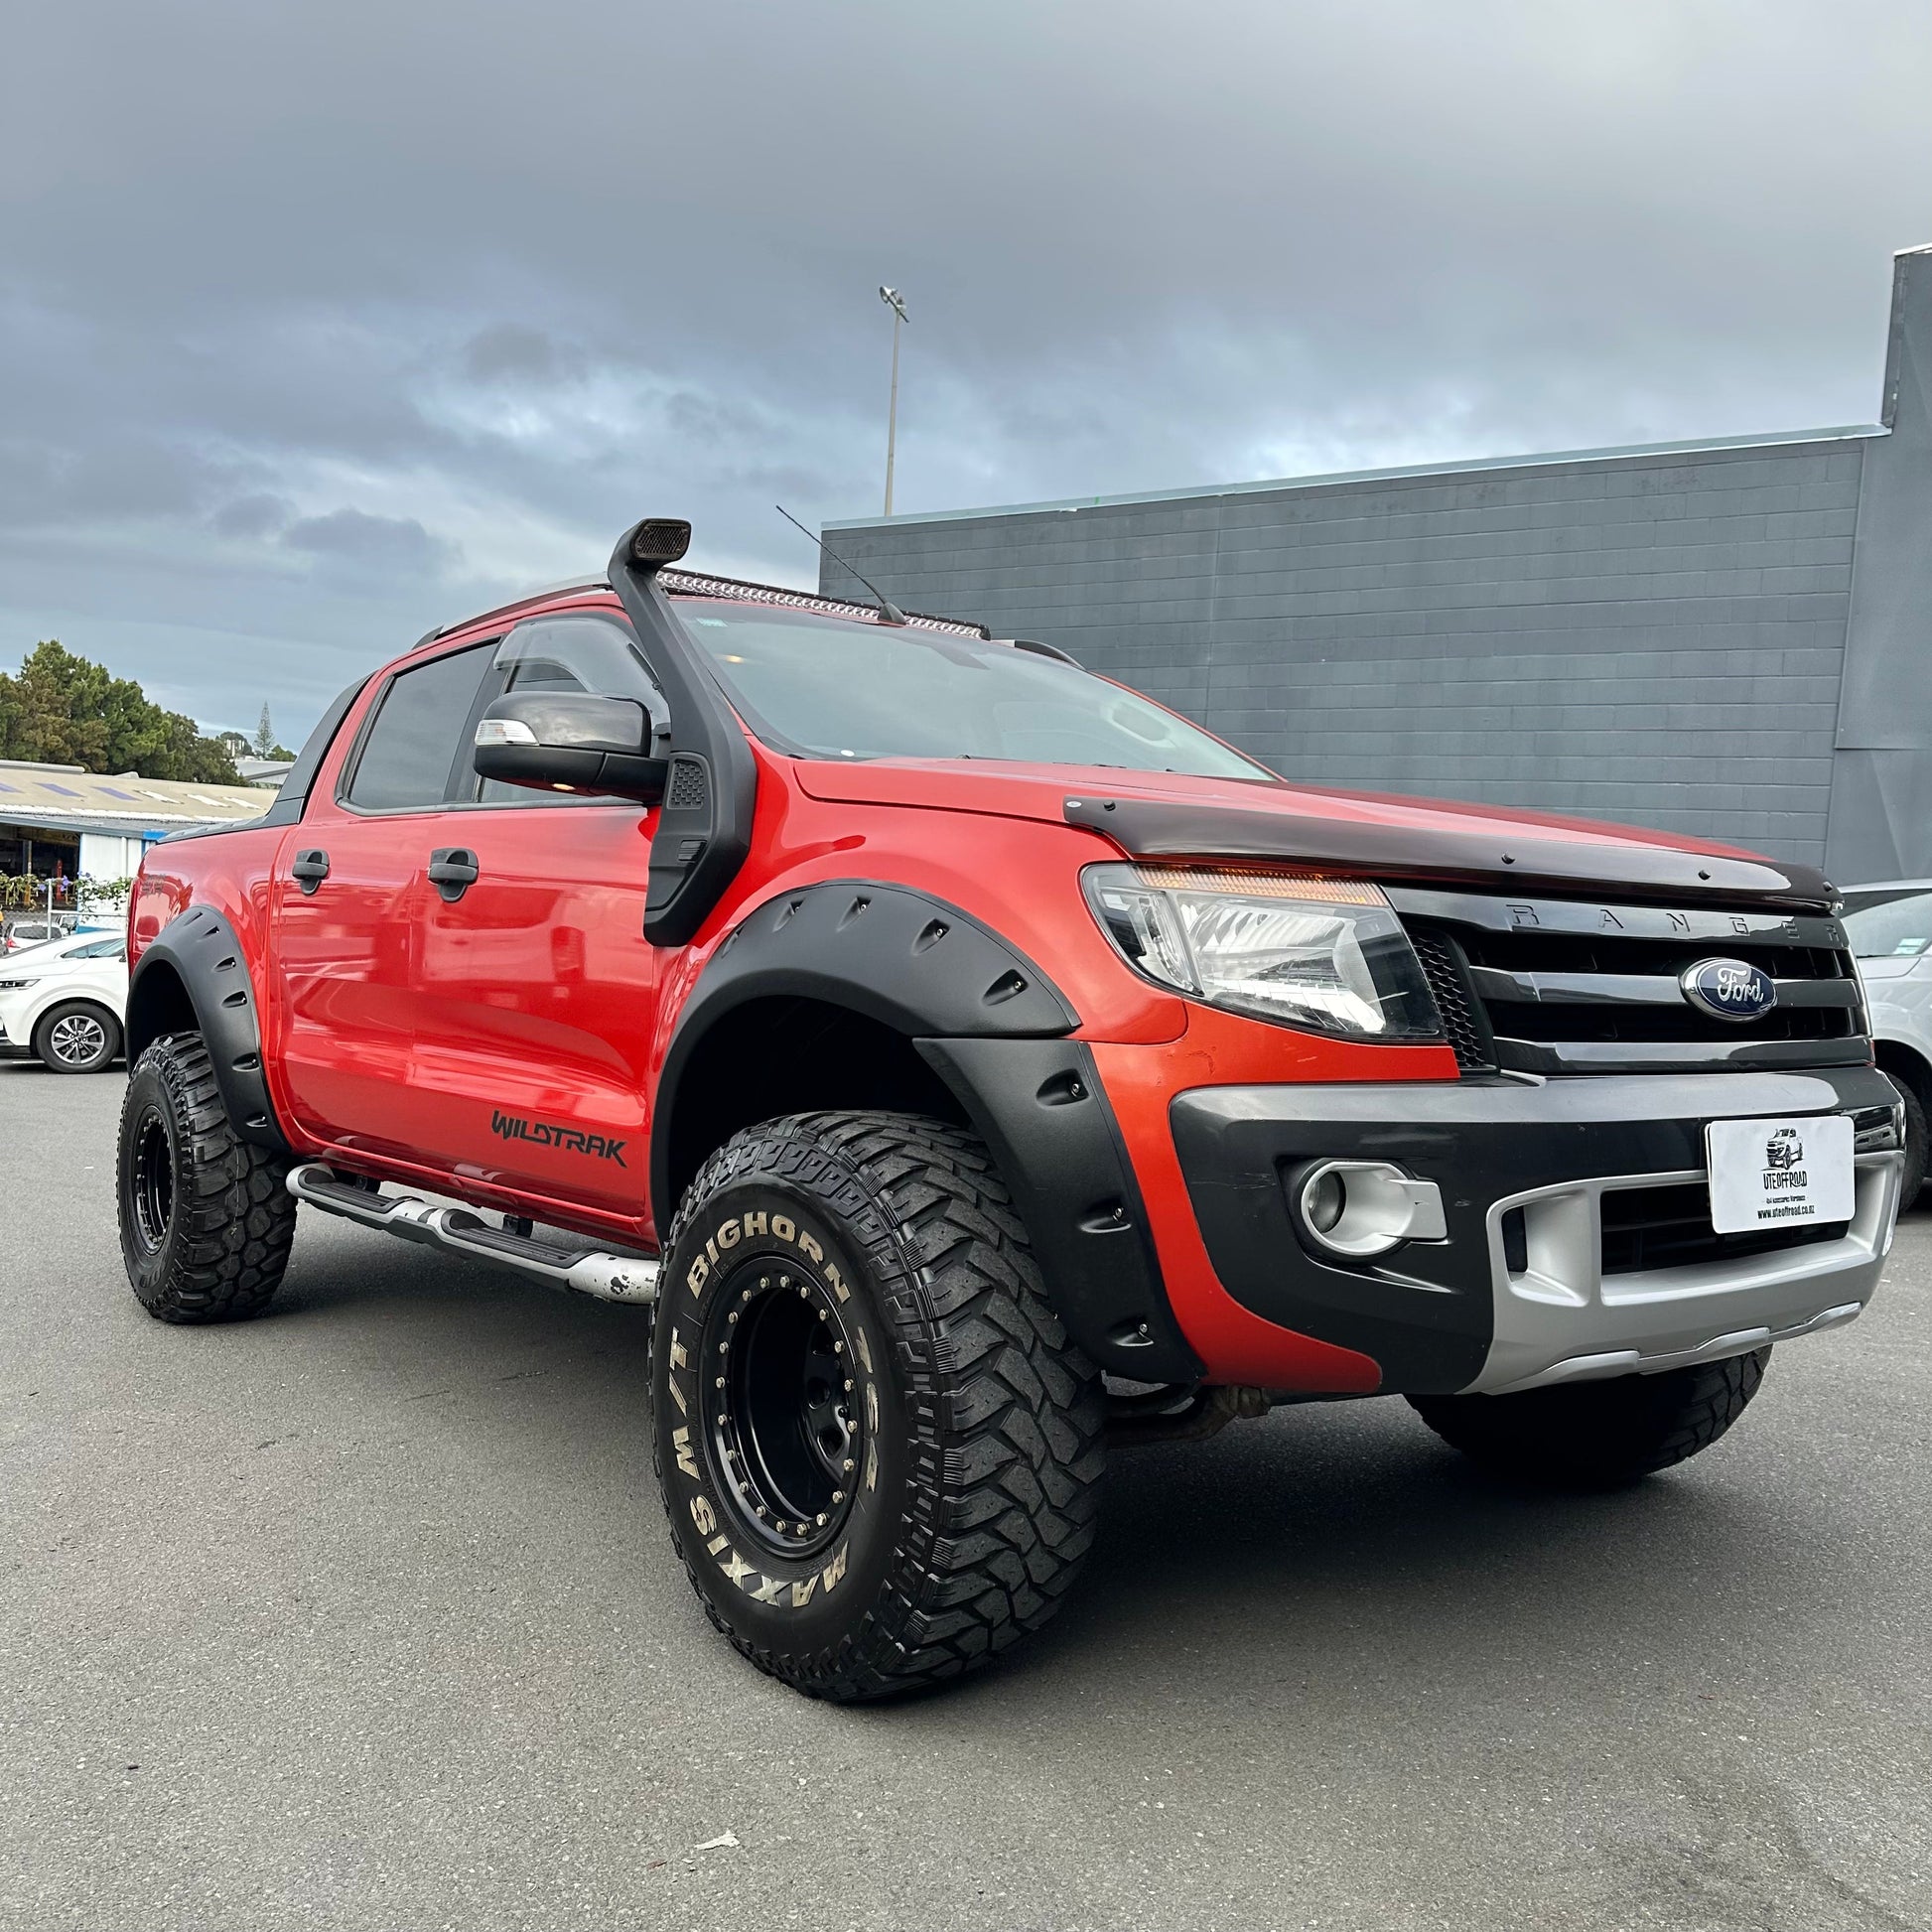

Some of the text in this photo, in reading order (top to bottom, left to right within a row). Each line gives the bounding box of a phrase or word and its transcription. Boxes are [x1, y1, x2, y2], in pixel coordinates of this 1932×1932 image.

[1505, 903, 1841, 941] RANGER
[1717, 967, 1765, 1003] Ford
[491, 1110, 627, 1169] WILDTRAK
[1757, 1204, 1816, 1219] www.uteoffroad.co.nz
[686, 1210, 851, 1304] BIGHORN
[668, 1326, 701, 1480] M/T
[689, 1494, 850, 1607] MAXXIS
